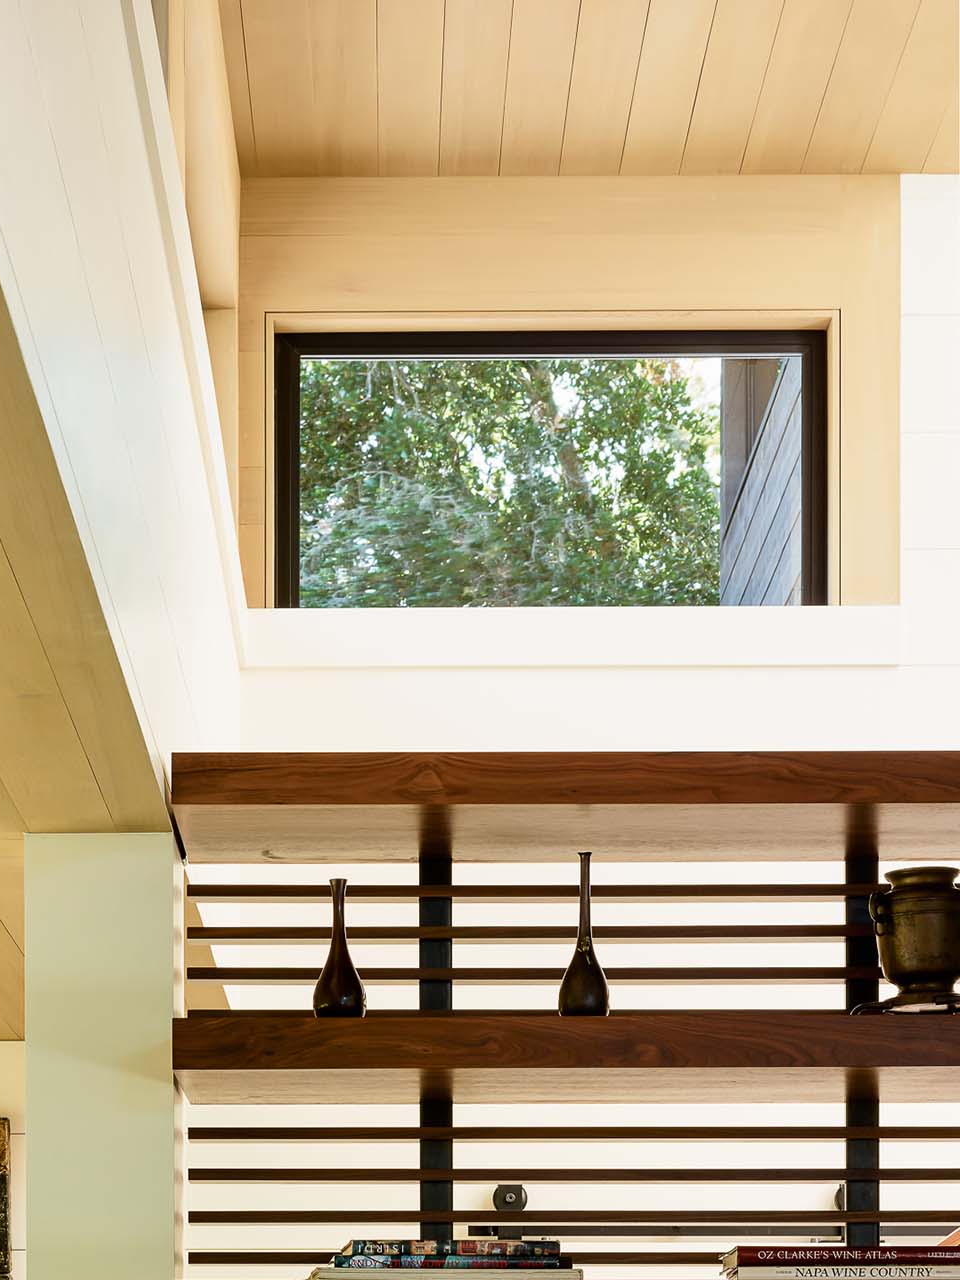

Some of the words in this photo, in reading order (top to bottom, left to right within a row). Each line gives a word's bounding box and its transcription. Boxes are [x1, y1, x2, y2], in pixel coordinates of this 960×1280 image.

[758, 1251, 773, 1260] OZ
[777, 1250, 829, 1260] CLARKE'S
[832, 1251, 862, 1260] WINE
[865, 1250, 897, 1260] ATLAS
[795, 1267, 829, 1277] NAPA
[831, 1267, 866, 1277] WINE
[870, 1267, 933, 1277] COUNTRY
